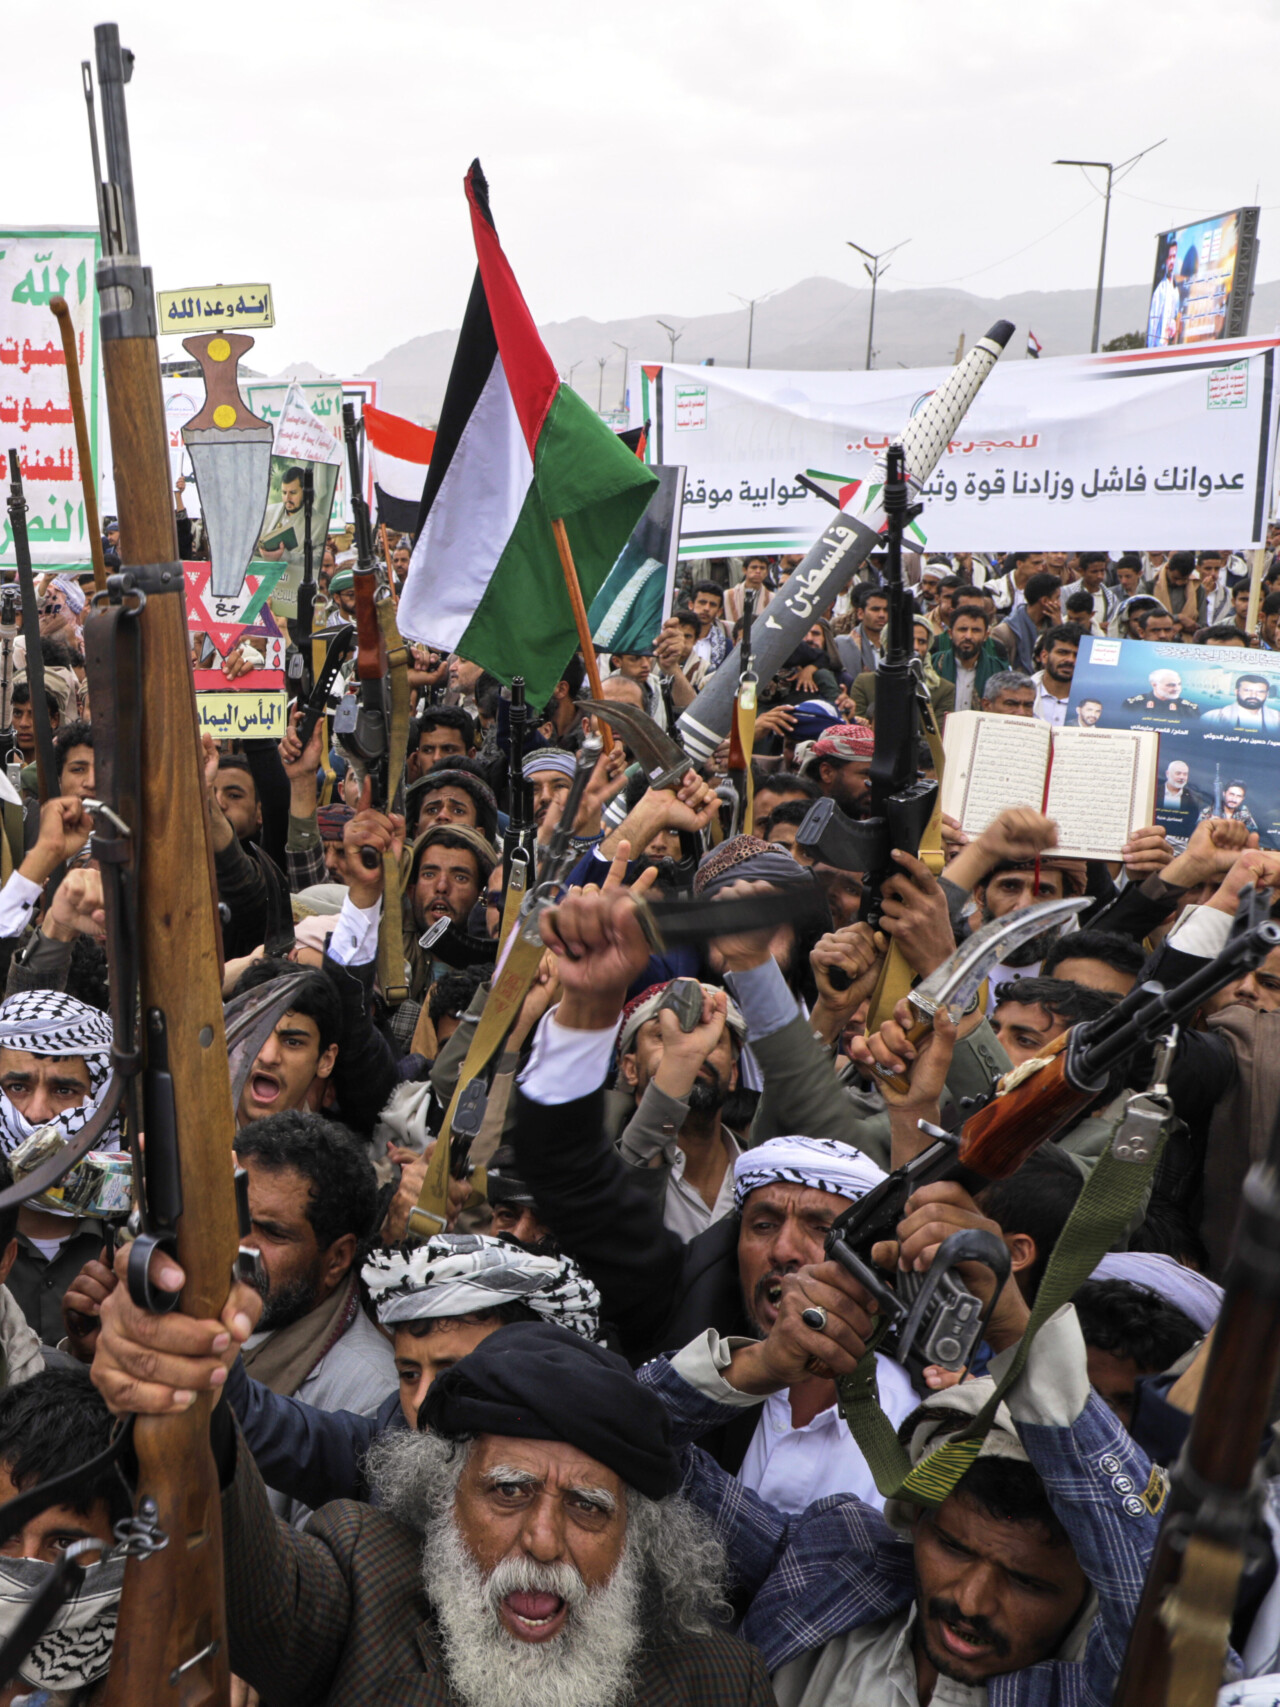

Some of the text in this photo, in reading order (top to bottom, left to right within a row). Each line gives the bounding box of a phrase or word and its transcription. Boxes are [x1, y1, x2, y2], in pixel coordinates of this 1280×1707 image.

[11, 251, 87, 306] الله
[167, 296, 202, 320] الله
[235, 294, 270, 322] إنه
[682, 478, 808, 510] صوابية موقف
[964, 467, 1006, 501] قوة
[1012, 469, 1074, 501] وزادنا
[1081, 465, 1147, 499] فاشل
[1154, 465, 1245, 498] عدوانك
[786, 525, 858, 618] فلسطين
[197, 699, 282, 732] البأس اليما
